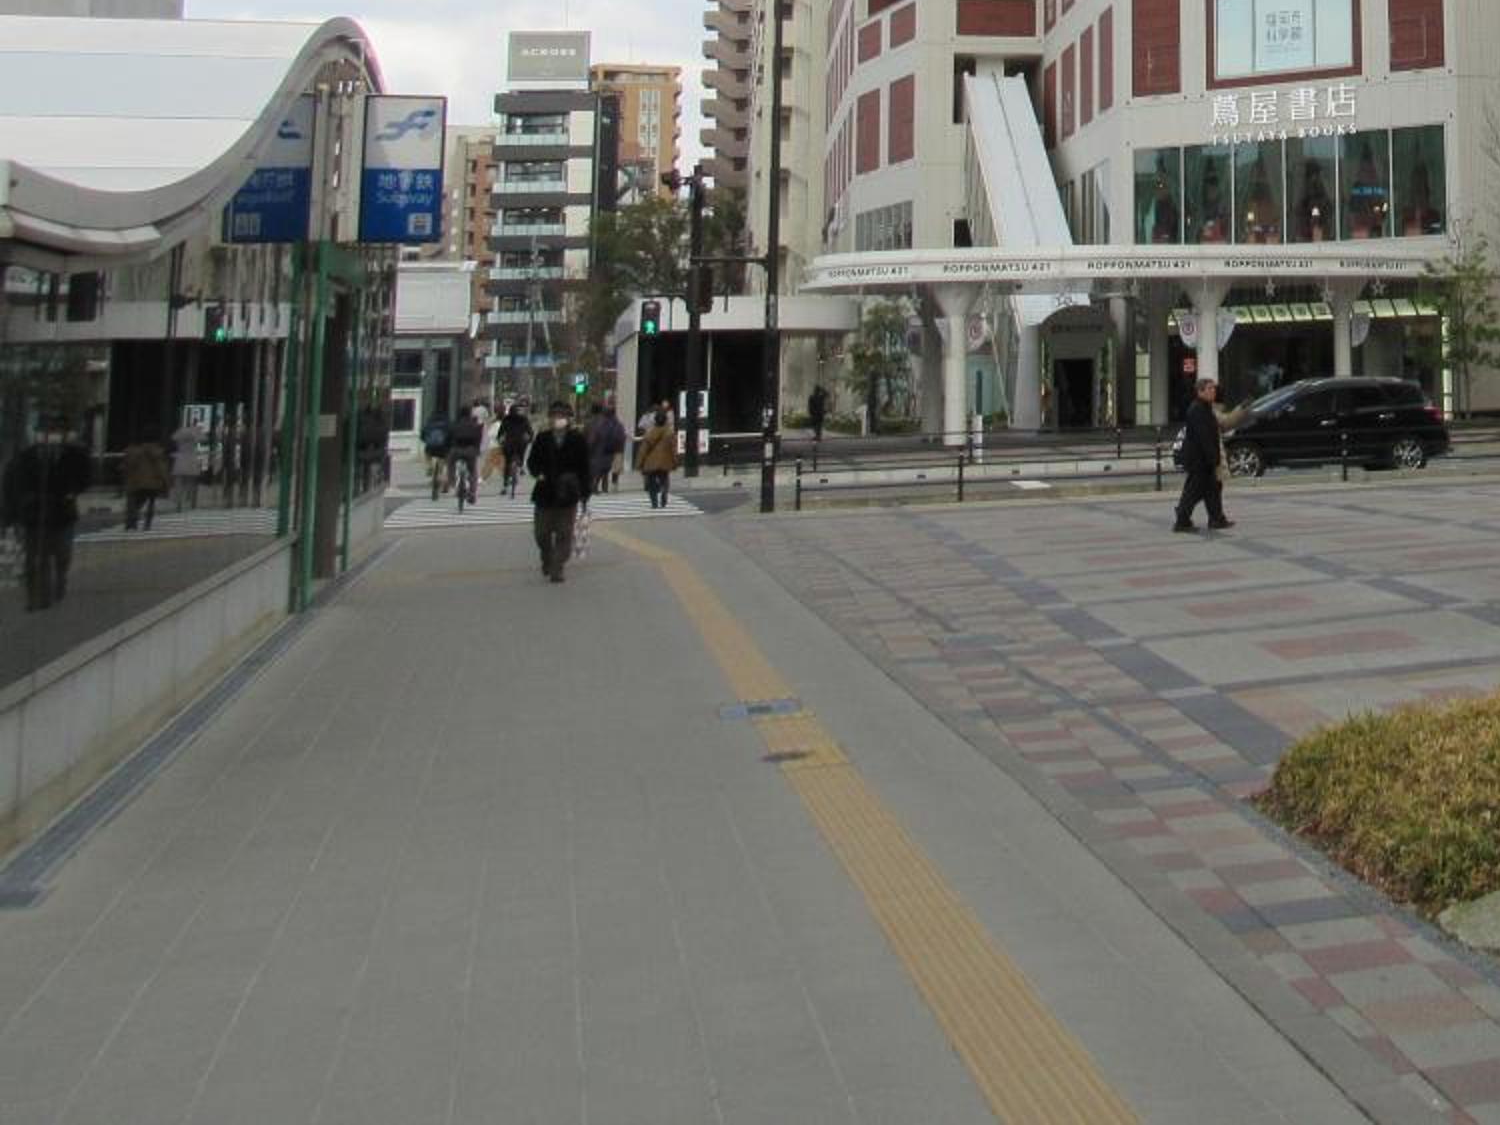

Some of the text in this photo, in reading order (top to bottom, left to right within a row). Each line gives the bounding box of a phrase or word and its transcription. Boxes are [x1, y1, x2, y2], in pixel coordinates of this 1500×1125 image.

[1212, 83, 1357, 127] 蔦屋書店
[1298, 122, 1358, 139] BOOKS
[943, 262, 1029, 274] ROPPONMATSU
[1087, 259, 1170, 270] ROPPONMATSU
